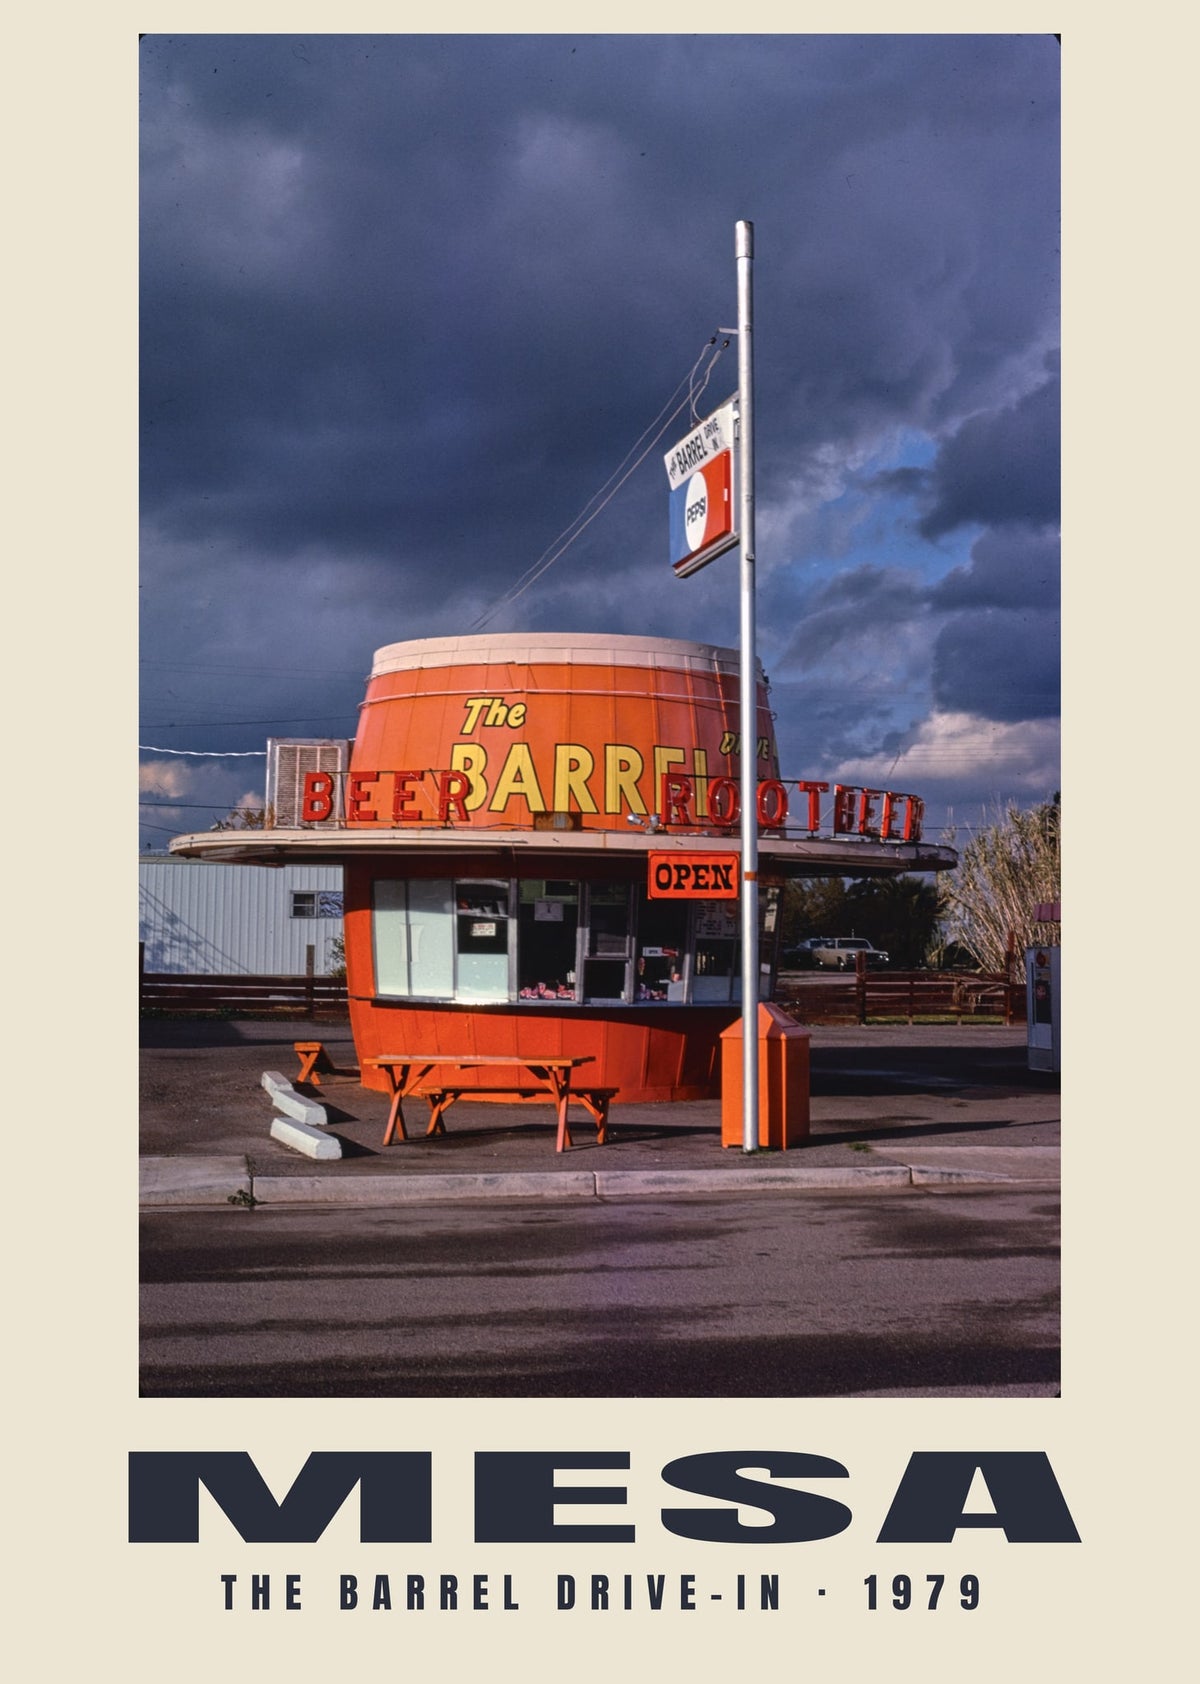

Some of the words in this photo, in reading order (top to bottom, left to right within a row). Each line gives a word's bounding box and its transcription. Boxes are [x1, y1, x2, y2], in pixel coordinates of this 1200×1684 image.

[703, 417, 719, 439] DRIVE
[676, 433, 708, 475] BARREL
[686, 496, 706, 527] PEPSI
[460, 697, 527, 735] The
[302, 771, 471, 822] BEER
[660, 773, 829, 832] ROOT
[834, 783, 925, 842] BEER
[655, 863, 733, 890] OPEN
